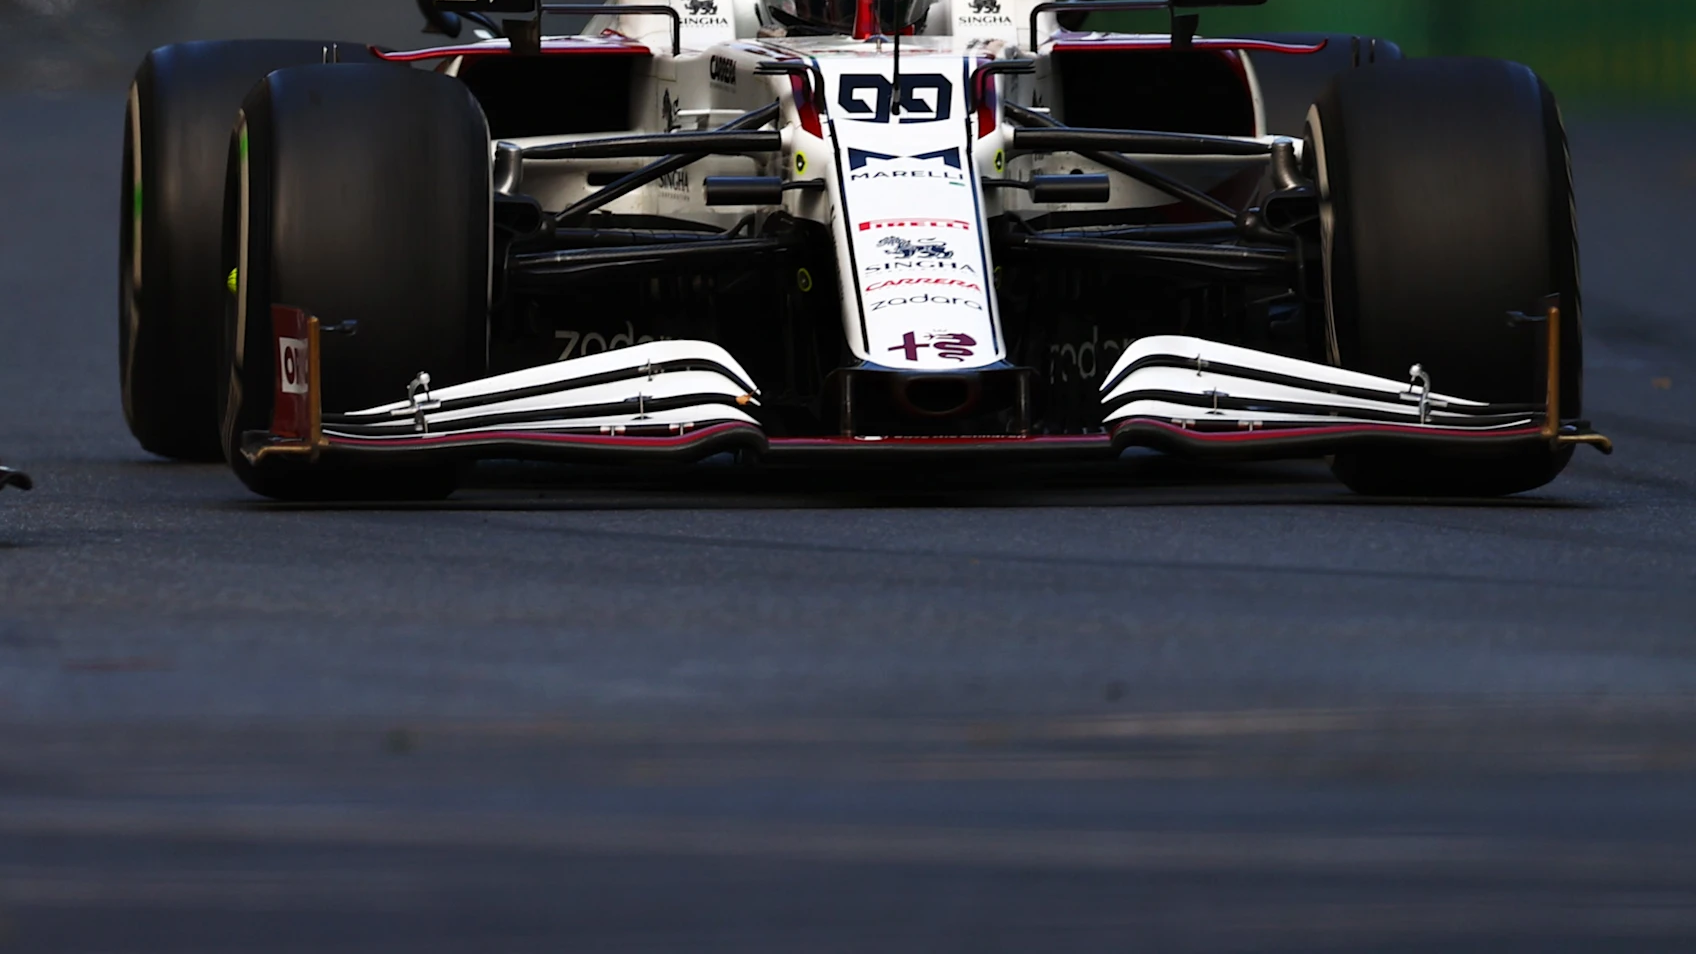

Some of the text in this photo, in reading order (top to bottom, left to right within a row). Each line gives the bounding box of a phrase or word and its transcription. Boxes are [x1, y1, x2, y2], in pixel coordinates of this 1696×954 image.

[958, 15, 1012, 24] SINGHA
[837, 72, 954, 125] 99
[850, 169, 965, 182] MARELLI
[858, 217, 970, 233] PIRELLI
[864, 260, 977, 275] SINGHA
[865, 277, 982, 293] CARRERA
[870, 293, 984, 312] zadara
